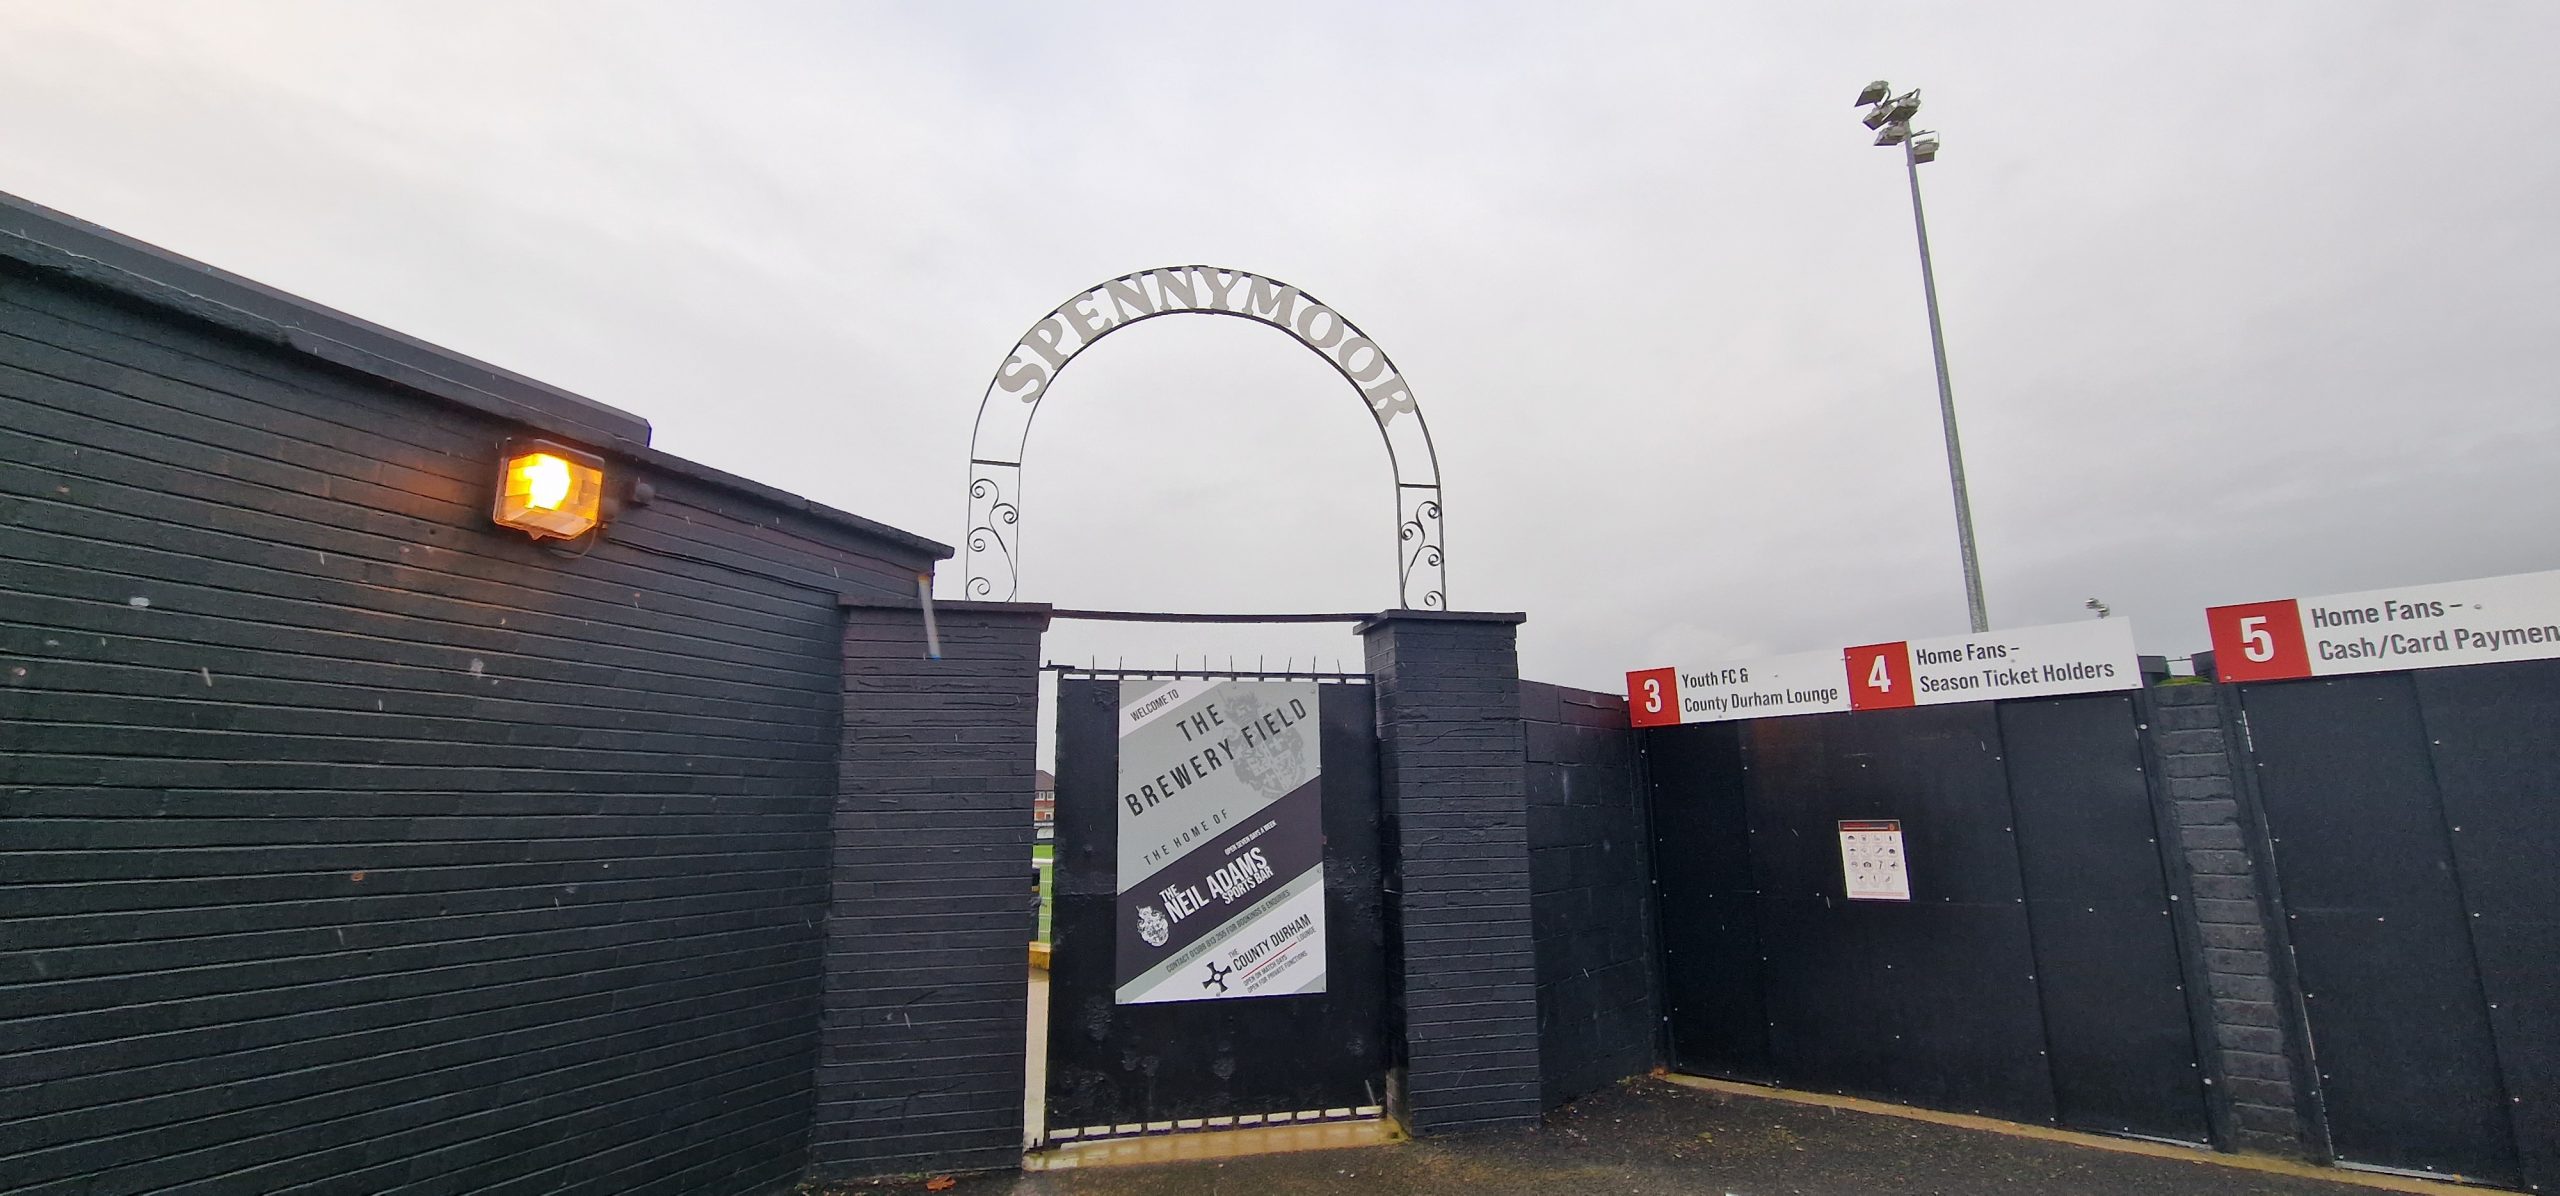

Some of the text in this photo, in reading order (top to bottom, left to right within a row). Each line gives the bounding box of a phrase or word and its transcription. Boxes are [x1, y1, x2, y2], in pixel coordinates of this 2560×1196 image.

[997, 266, 1416, 427] SPENNYMOOR
[2312, 605, 2380, 628] Home
[2385, 600, 2445, 622] Fans
[1916, 648, 1963, 666] Home
[1967, 643, 2007, 661] Fans
[2240, 616, 2275, 663] 5
[2318, 625, 2560, 661] Cash/Card Paymen
[1682, 668, 1749, 689] Youth FC &
[1868, 655, 1892, 693] 4
[1919, 661, 2115, 693] Season Ticket Holders
[1130, 689, 1179, 722] WELCOME TO
[1643, 679, 1662, 713] 3
[1684, 688, 1838, 713] County Durham Lounge
[1176, 703, 1225, 742] THE
[1125, 698, 1307, 817] BREWERY FIELD
[1143, 808, 1229, 866] THE HOME OF
[1159, 883, 1180, 902] THE
[1164, 847, 1268, 924] NEIL ADAMS
[1221, 866, 1274, 905] SPORTS BAR
[1233, 913, 1312, 971] COUNTY DURHAM
[1296, 926, 1317, 942] LOUNGE
[1228, 948, 1239, 959] THE
